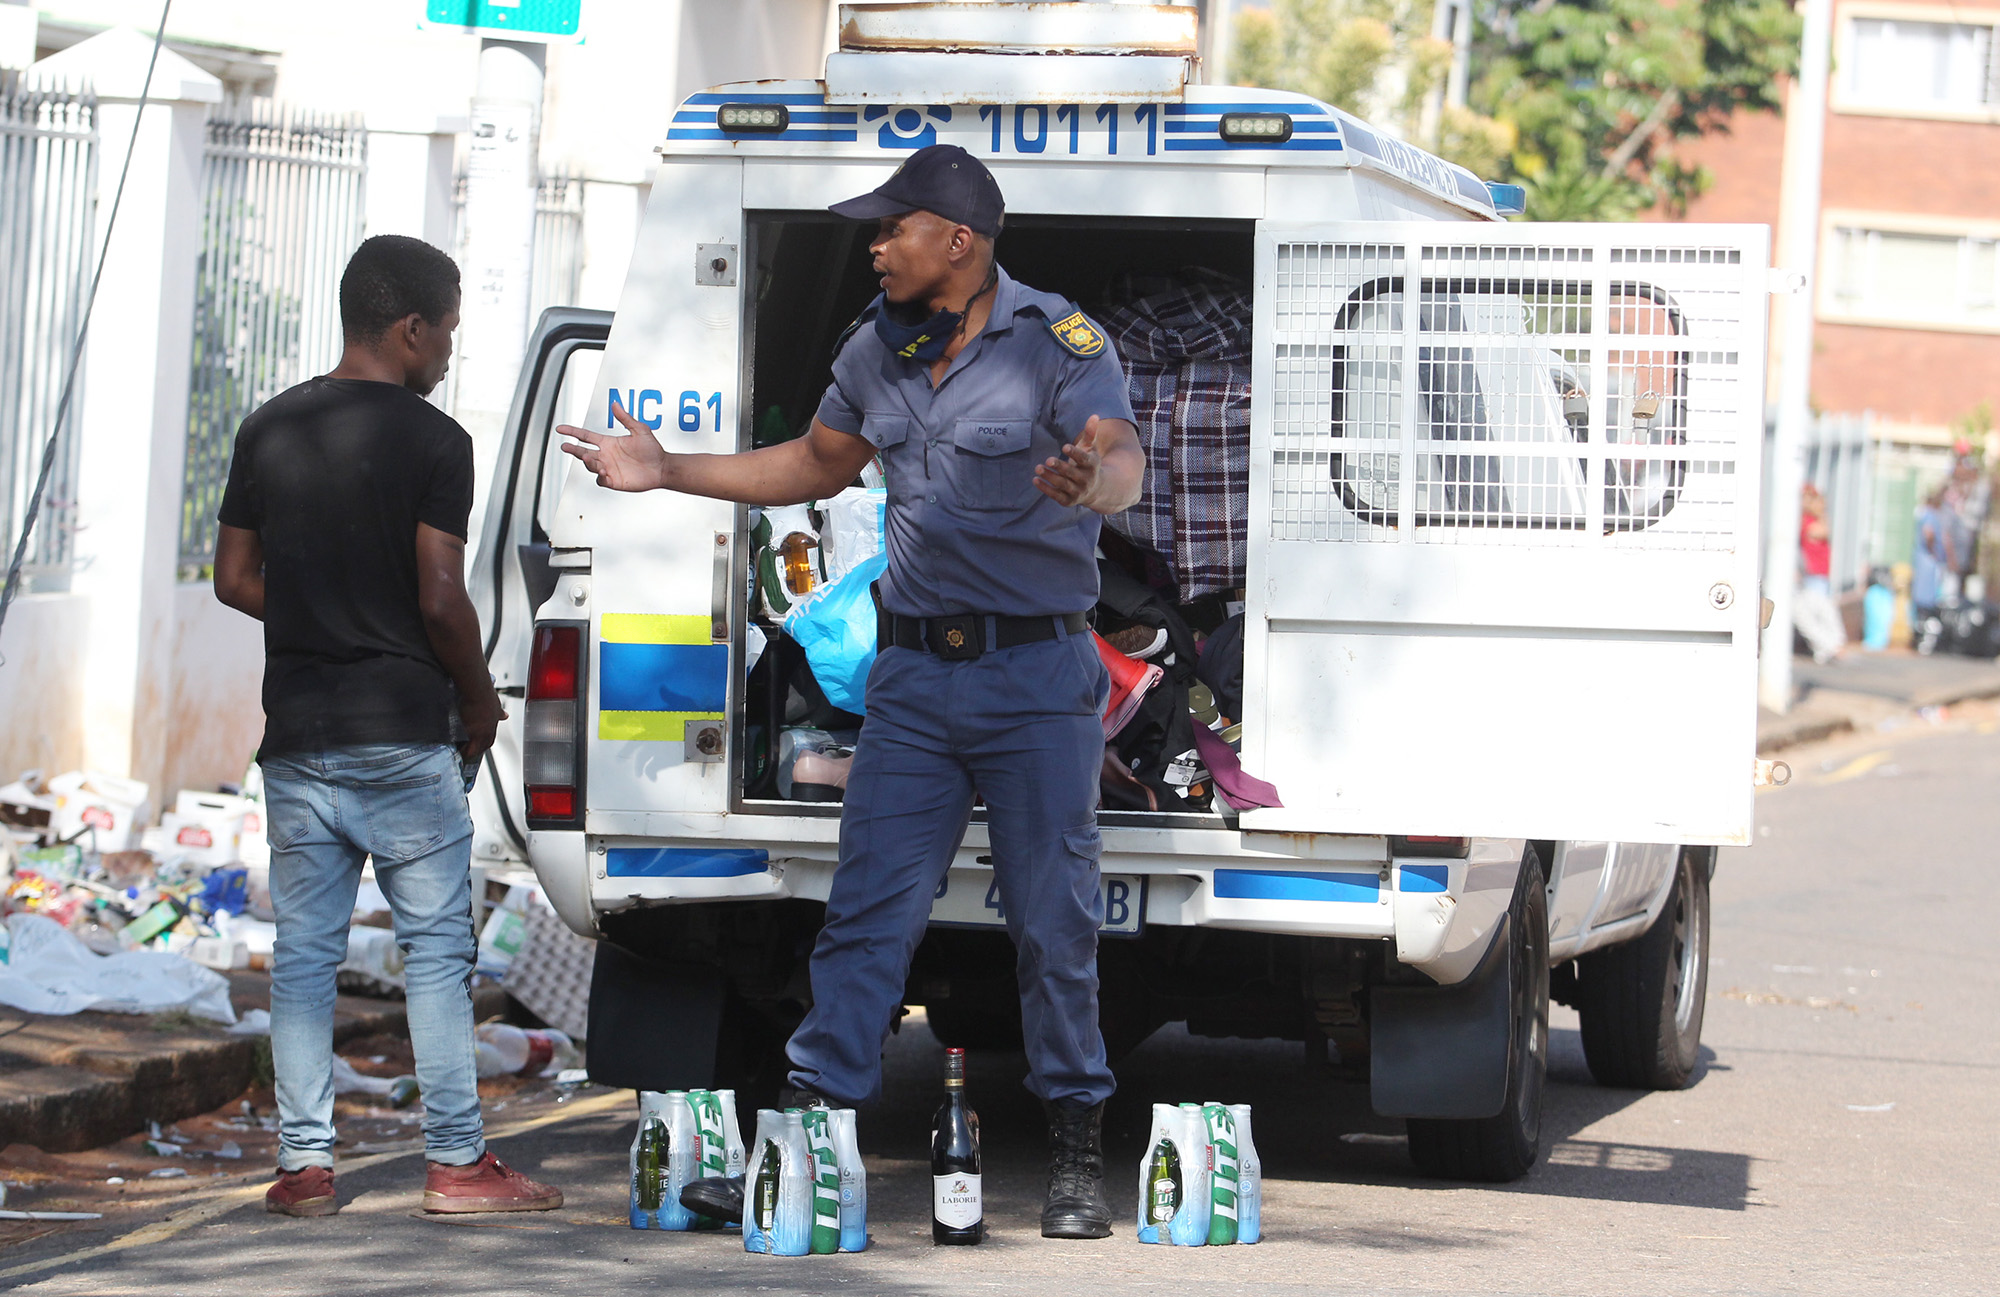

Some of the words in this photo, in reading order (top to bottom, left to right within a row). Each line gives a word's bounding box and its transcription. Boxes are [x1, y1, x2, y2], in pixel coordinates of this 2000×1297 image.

[978, 103, 1157, 156] 10111
[1055, 315, 1084, 335] POLICE
[607, 388, 663, 430] NC
[678, 390, 722, 432] 61
[977, 426, 1008, 441] POLICE
[1105, 879, 1130, 926] B
[808, 1120, 841, 1230] LITE
[1210, 1113, 1239, 1223] LITE
[942, 1196, 978, 1204] LABORIE
